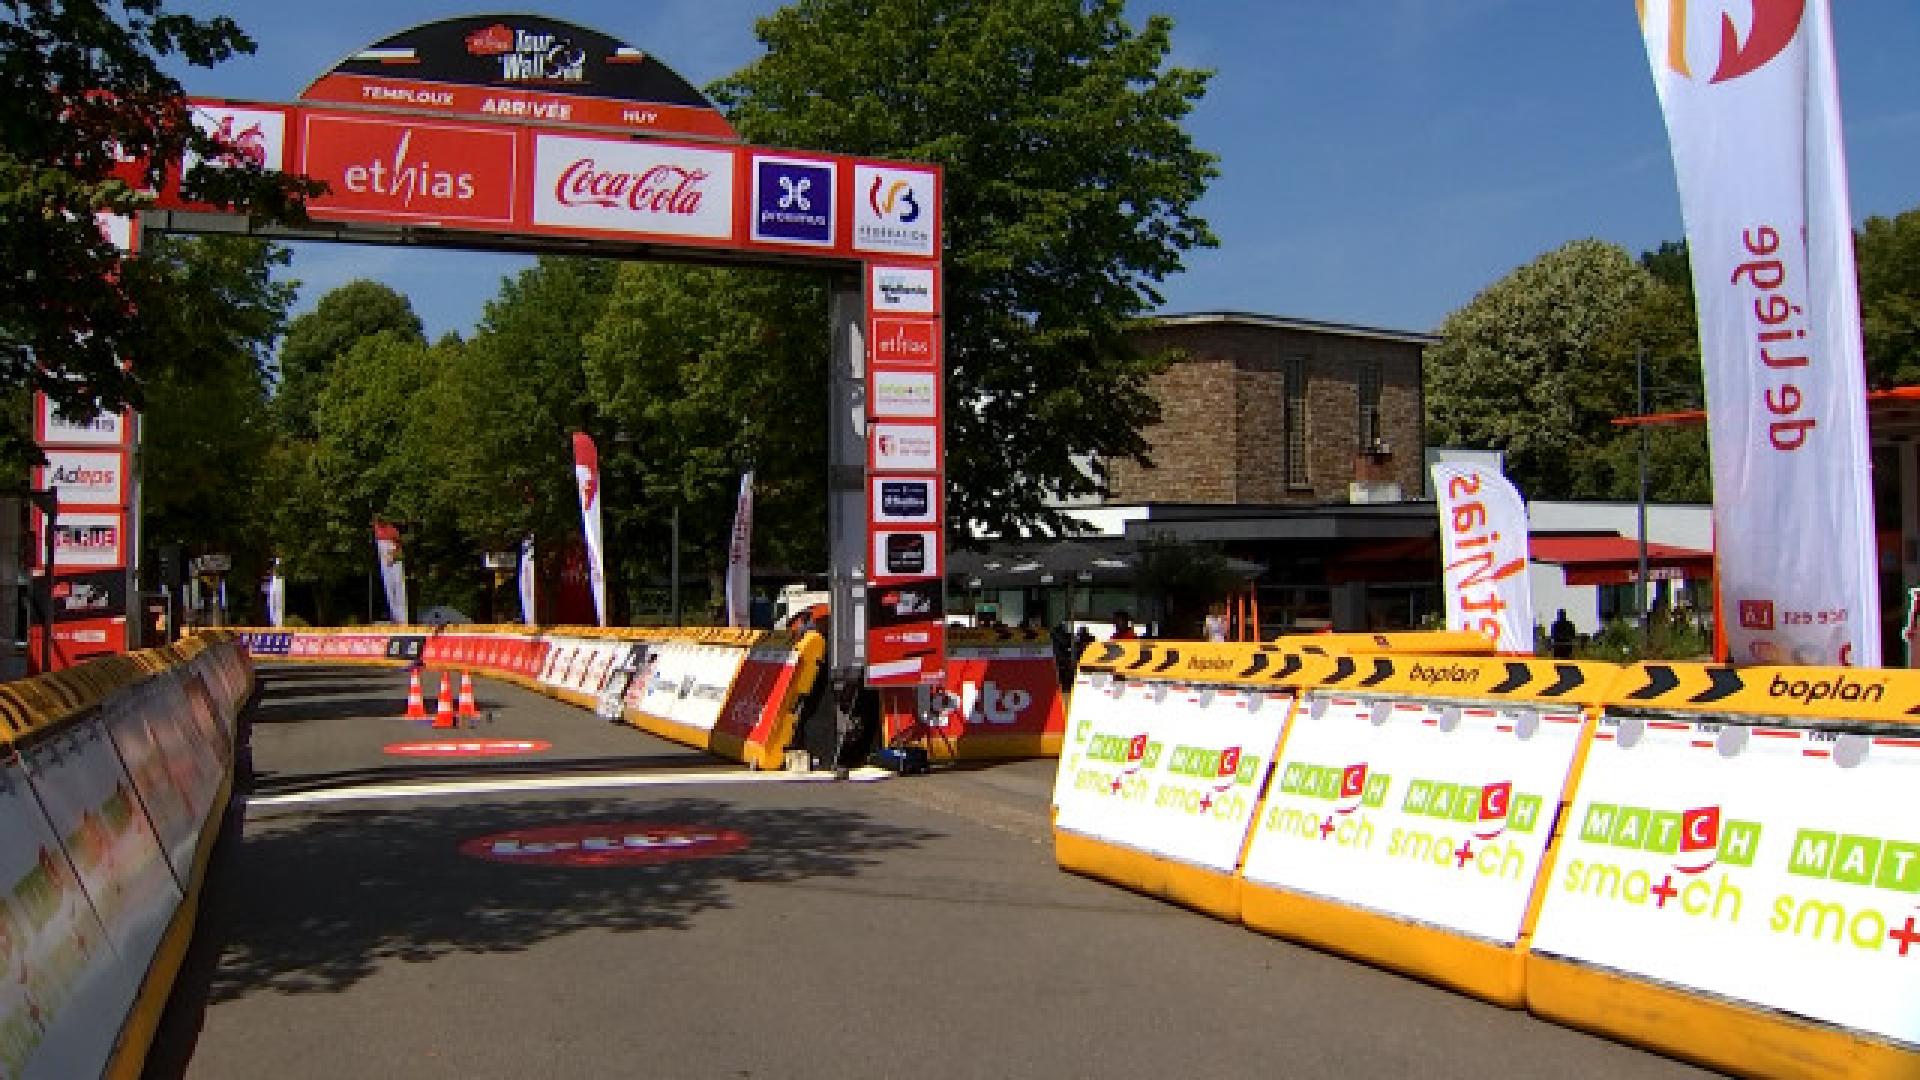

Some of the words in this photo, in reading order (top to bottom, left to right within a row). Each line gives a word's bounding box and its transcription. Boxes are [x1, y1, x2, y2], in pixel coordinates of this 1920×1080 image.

[362, 85, 454, 106] TEMPLOUX
[623, 109, 658, 124] HUY
[344, 128, 476, 208] ethias
[760, 211, 826, 226] proximus
[1409, 661, 1481, 687] boplan
[1768, 673, 1886, 705] boplan
[1169, 746, 1260, 785] MATCH
[1281, 764, 1391, 807] MATCH
[1403, 781, 1542, 832] MATCH
[1580, 806, 1760, 866] MATCH
